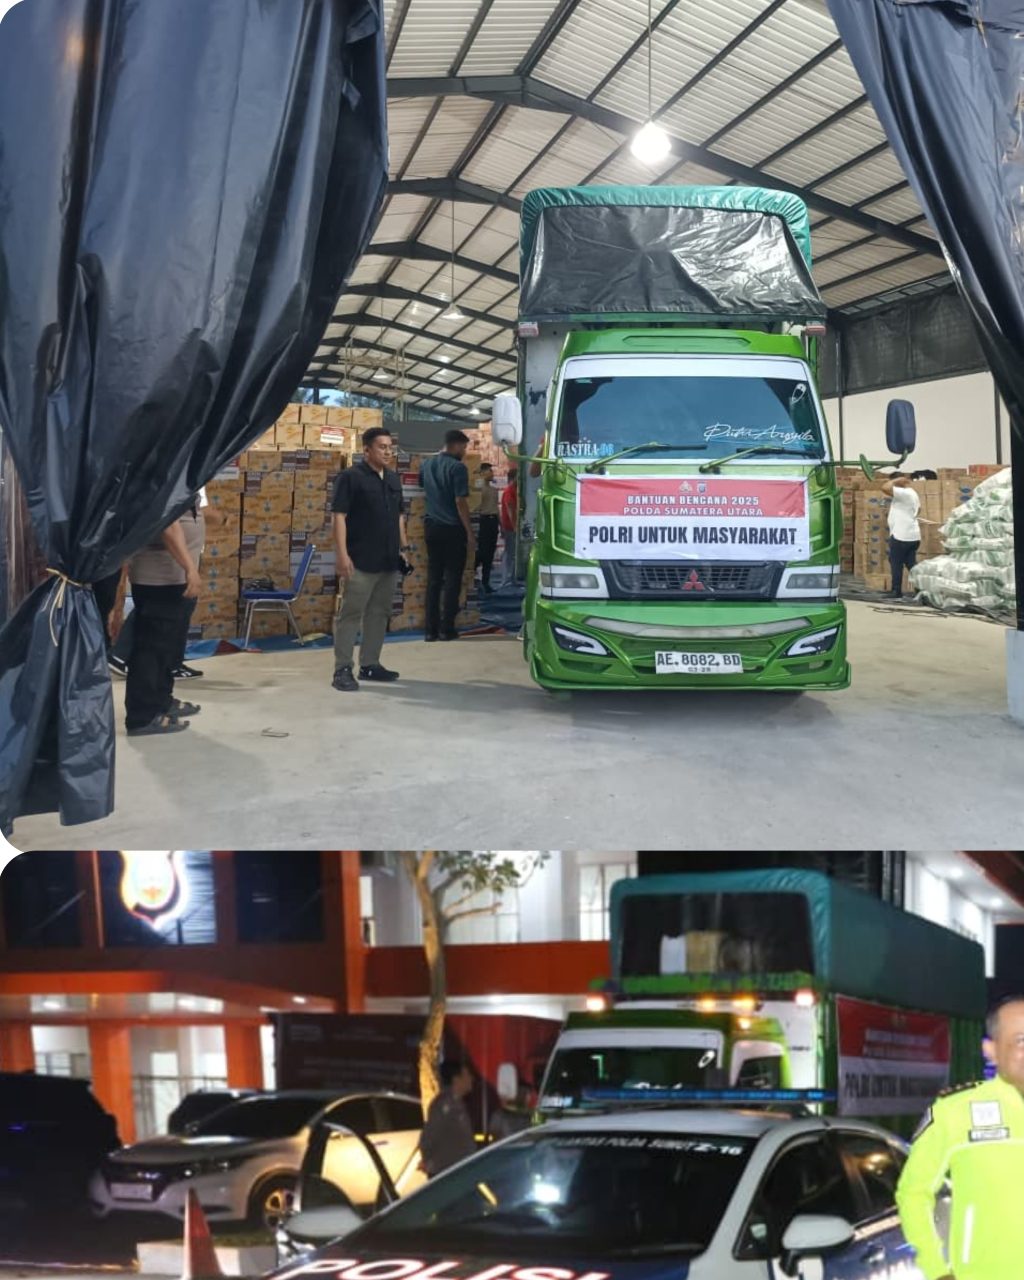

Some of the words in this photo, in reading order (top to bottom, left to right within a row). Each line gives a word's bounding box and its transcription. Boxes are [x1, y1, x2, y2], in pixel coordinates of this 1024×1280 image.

[627, 495, 675, 505] BANTUAN
[679, 496, 728, 505] BENCANA
[731, 496, 759, 506] 2025
[623, 507, 661, 516] POLDA
[664, 507, 723, 516] SUMATERA
[727, 507, 763, 516] UTARA
[589, 526, 633, 544] POLRI
[638, 526, 687, 544] UNTUK
[693, 526, 797, 545] MASYARAKAT
